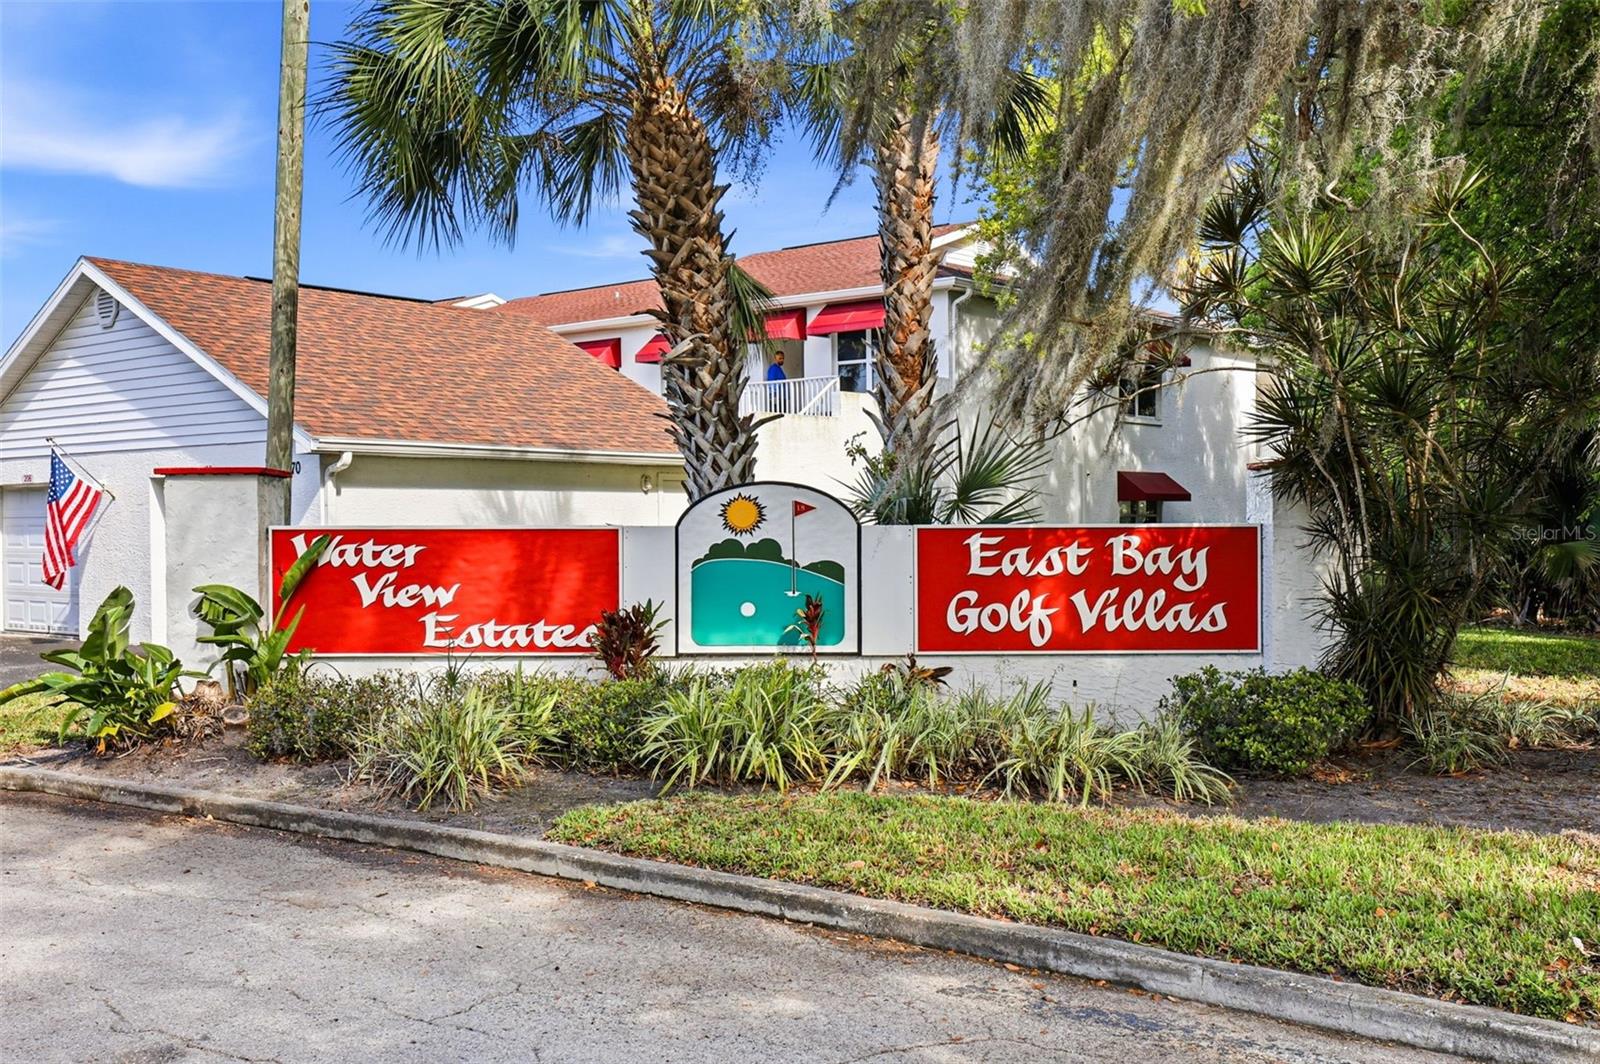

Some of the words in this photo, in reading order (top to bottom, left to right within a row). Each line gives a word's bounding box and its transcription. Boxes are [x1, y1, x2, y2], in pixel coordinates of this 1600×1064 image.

[351, 572, 461, 608] View
[964, 532, 1094, 577] East
[1105, 533, 1210, 592] Bay
[946, 588, 1060, 647] Golf
[1070, 587, 1228, 634] Villas
